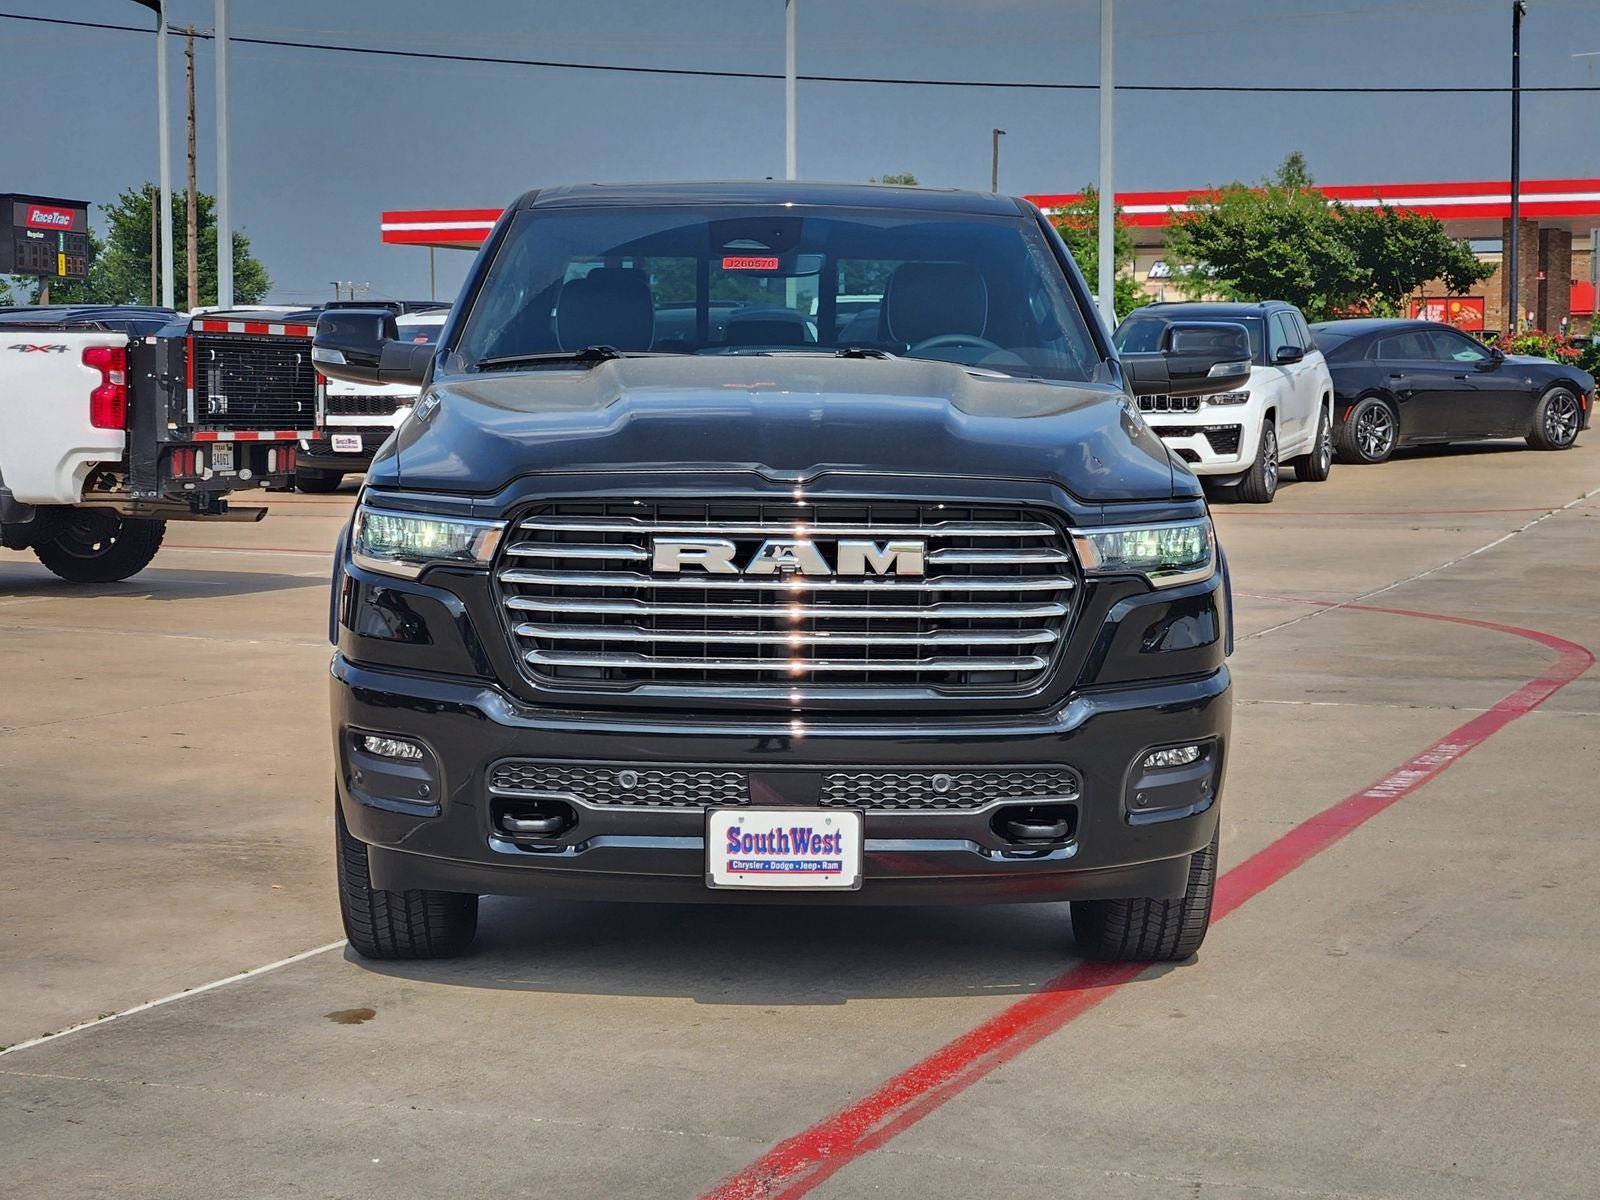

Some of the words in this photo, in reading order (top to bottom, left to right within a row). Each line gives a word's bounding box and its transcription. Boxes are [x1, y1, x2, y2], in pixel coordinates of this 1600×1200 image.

[31, 210, 70, 225] RaceTrac
[727, 260, 775, 268] J260570
[652, 537, 925, 575] RAM
[726, 826, 843, 856] SouthWest
[732, 860, 764, 870] Chrysler
[770, 860, 794, 871] Dodge
[800, 861, 817, 872] Jeep
[822, 861, 839, 870] Ram
